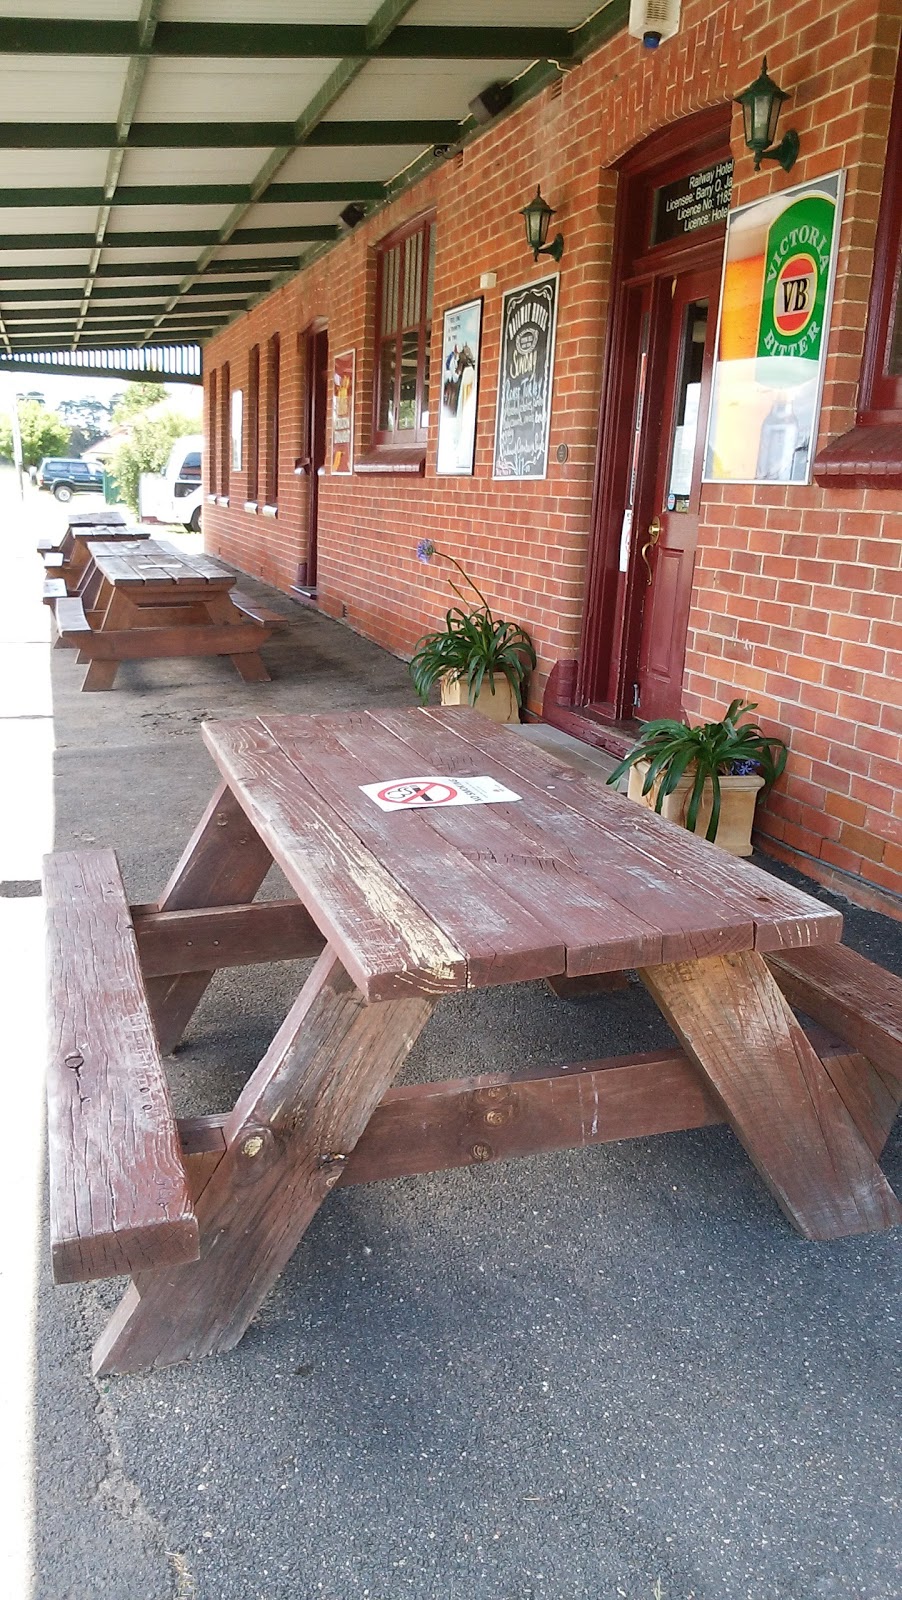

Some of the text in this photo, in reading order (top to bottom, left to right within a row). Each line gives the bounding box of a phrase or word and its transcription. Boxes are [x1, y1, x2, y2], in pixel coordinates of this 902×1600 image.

[689, 159, 734, 189] Railway Hotel
[666, 192, 695, 212] Licensee:
[696, 183, 713, 201] Barry
[677, 203, 701, 220] Licence
[684, 214, 711, 231] Licence:
[767, 225, 829, 283] VICTORIA
[782, 277, 810, 313] VB
[763, 321, 820, 357] BITTER
